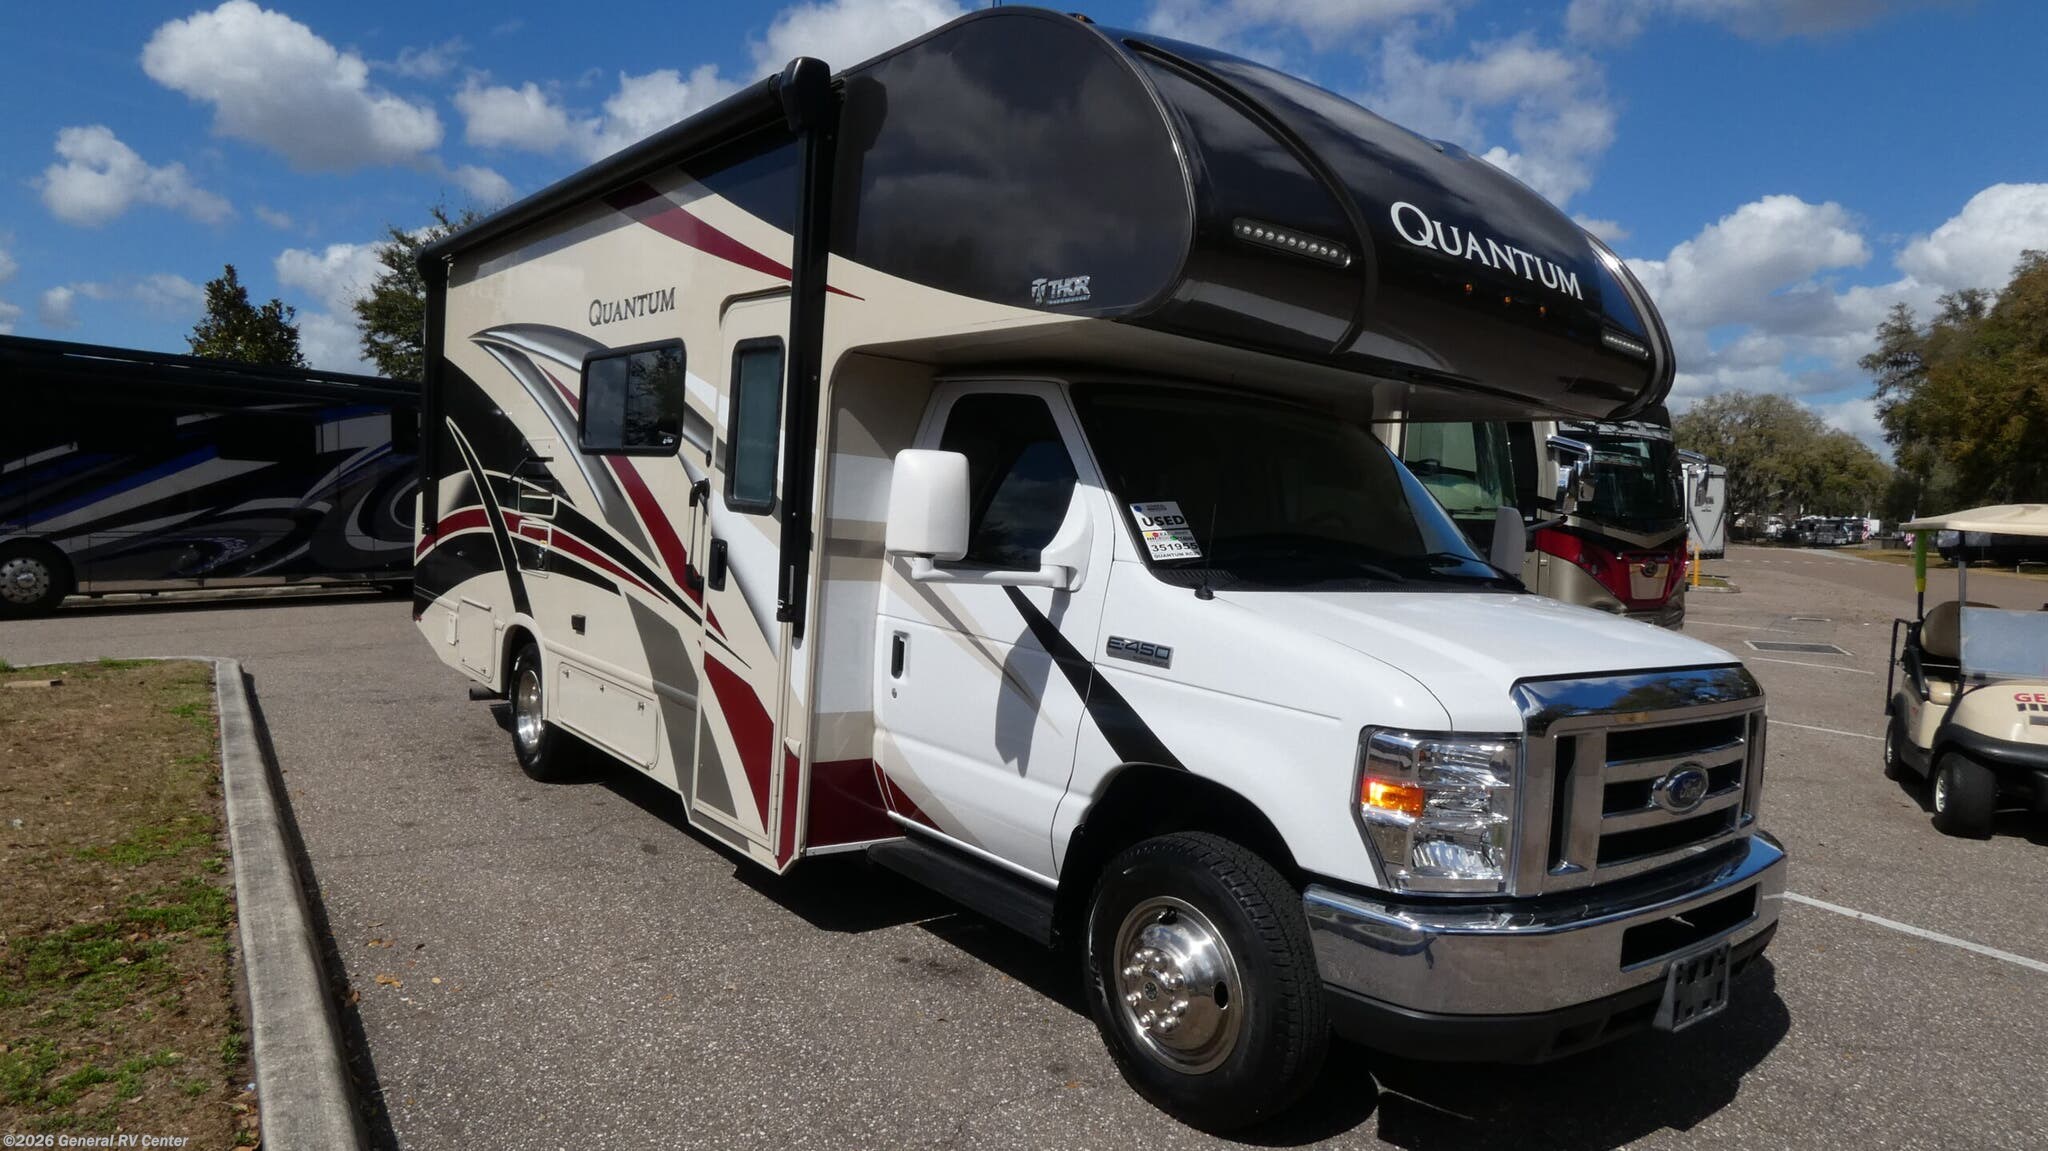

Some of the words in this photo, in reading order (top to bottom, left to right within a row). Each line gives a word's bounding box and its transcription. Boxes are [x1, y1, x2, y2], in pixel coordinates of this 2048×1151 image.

[1390, 201, 1584, 300] QUANTUM
[1047, 275, 1091, 299] THOR
[589, 287, 676, 326] QUANTUM
[1141, 515, 1186, 527] USED
[2014, 692, 2048, 704] GE
